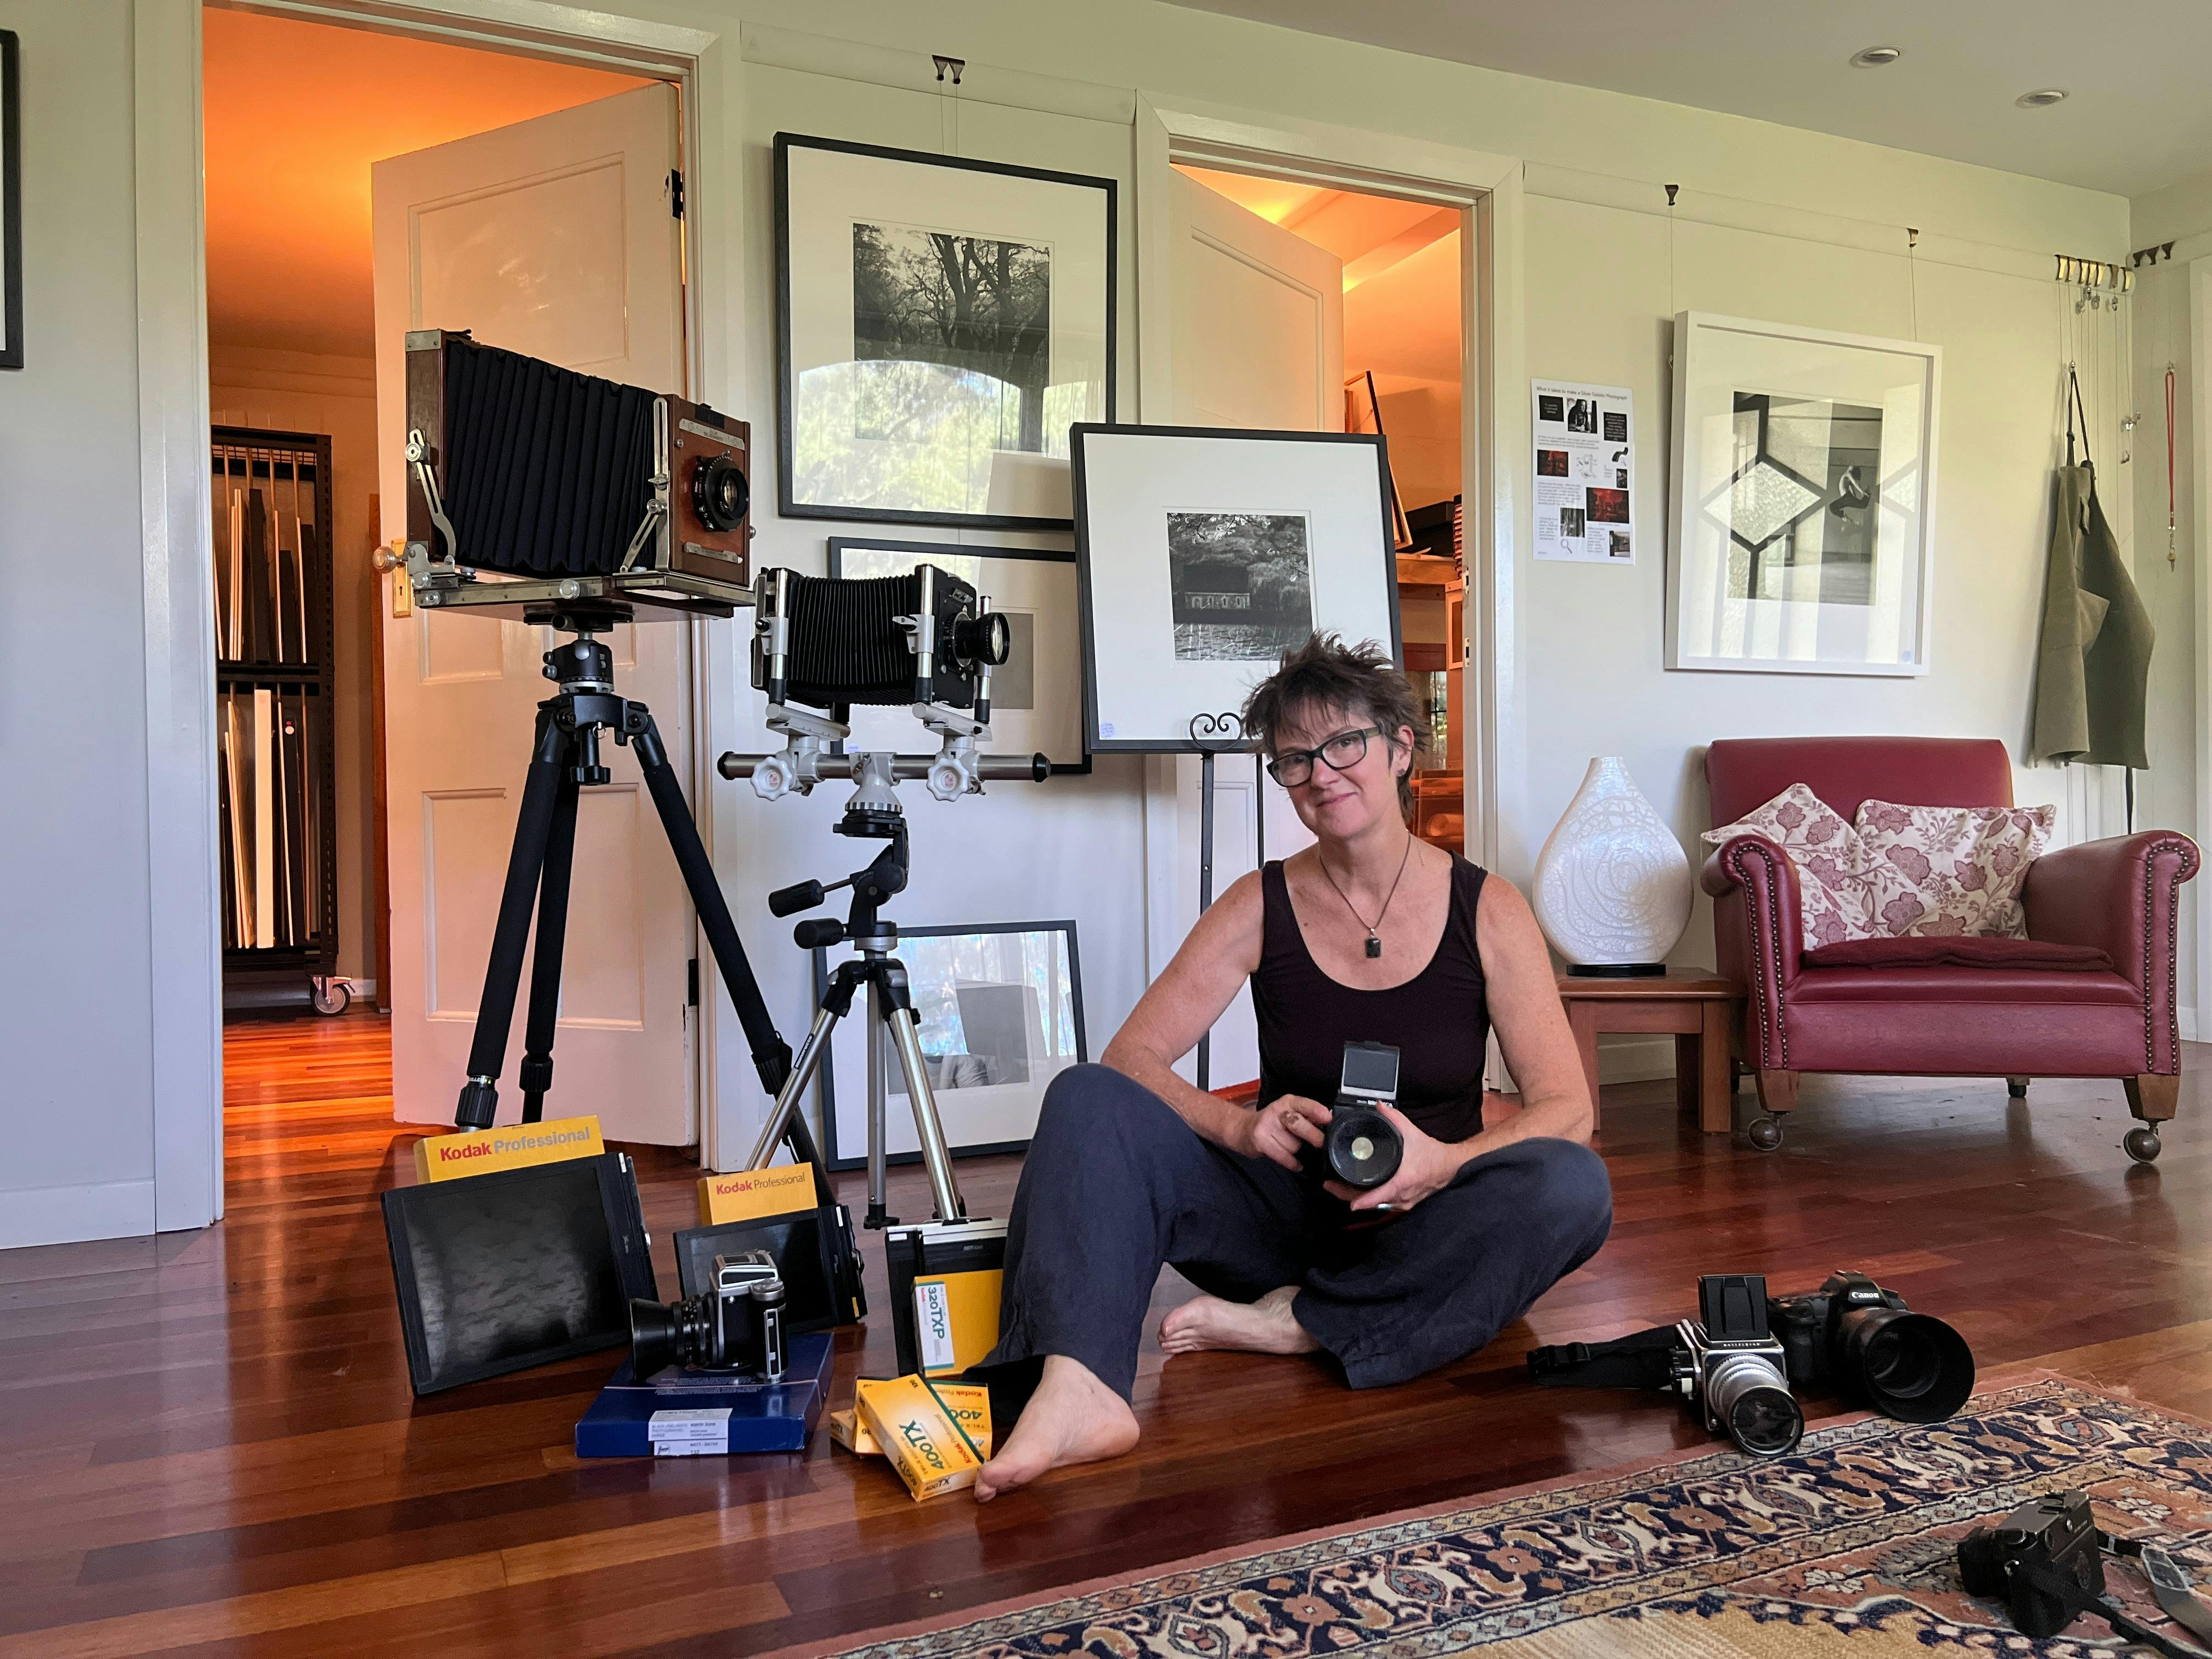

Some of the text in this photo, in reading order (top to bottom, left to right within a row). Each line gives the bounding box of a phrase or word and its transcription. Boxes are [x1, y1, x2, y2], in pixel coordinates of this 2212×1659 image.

[440, 1126, 590, 1161] Kodak Professional
[716, 1172, 805, 1194] Kodak Professional
[928, 1286, 945, 1339] 320TXP
[899, 1419, 945, 1469] 400TX
[955, 1442, 972, 1464] Kodak
